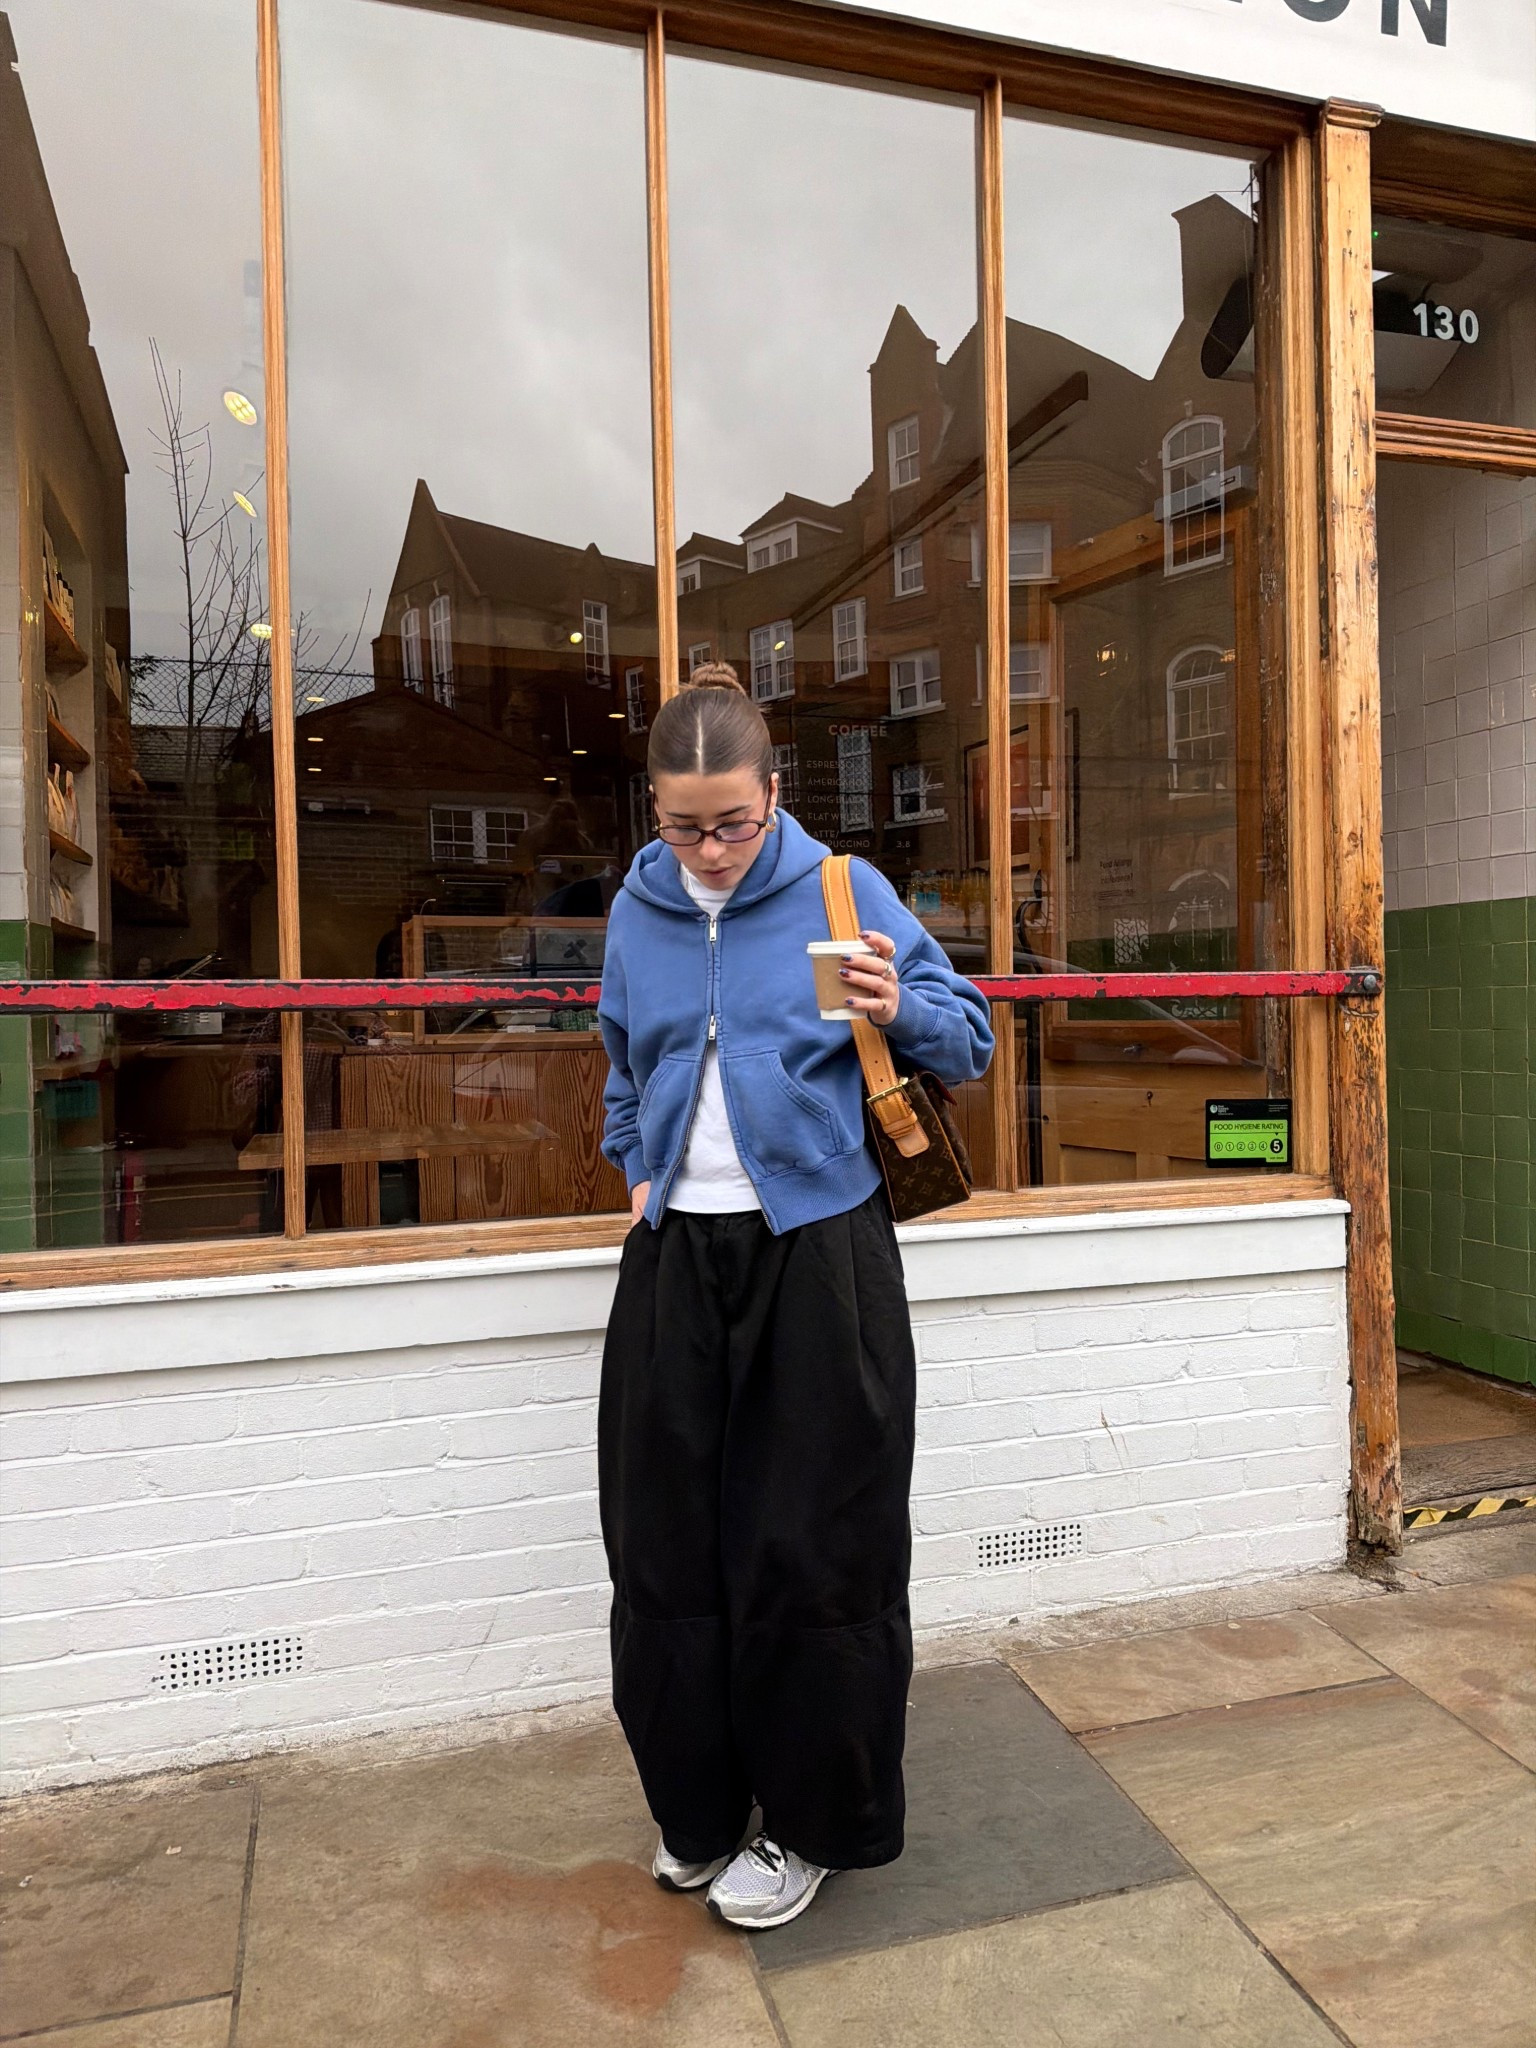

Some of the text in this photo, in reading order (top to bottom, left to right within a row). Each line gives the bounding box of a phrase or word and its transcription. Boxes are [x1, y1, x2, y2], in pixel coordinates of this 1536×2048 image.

[1412, 301, 1480, 344] 130
[828, 724, 888, 737] COFFEE
[806, 760, 854, 769] ESPRESSO
[807, 777, 863, 787] AMERICANO
[807, 795, 834, 804] LONG
[807, 812, 830, 821] FLAT
[1214, 1123, 1233, 1131] FOOD
[1273, 1140, 1280, 1152] 5
